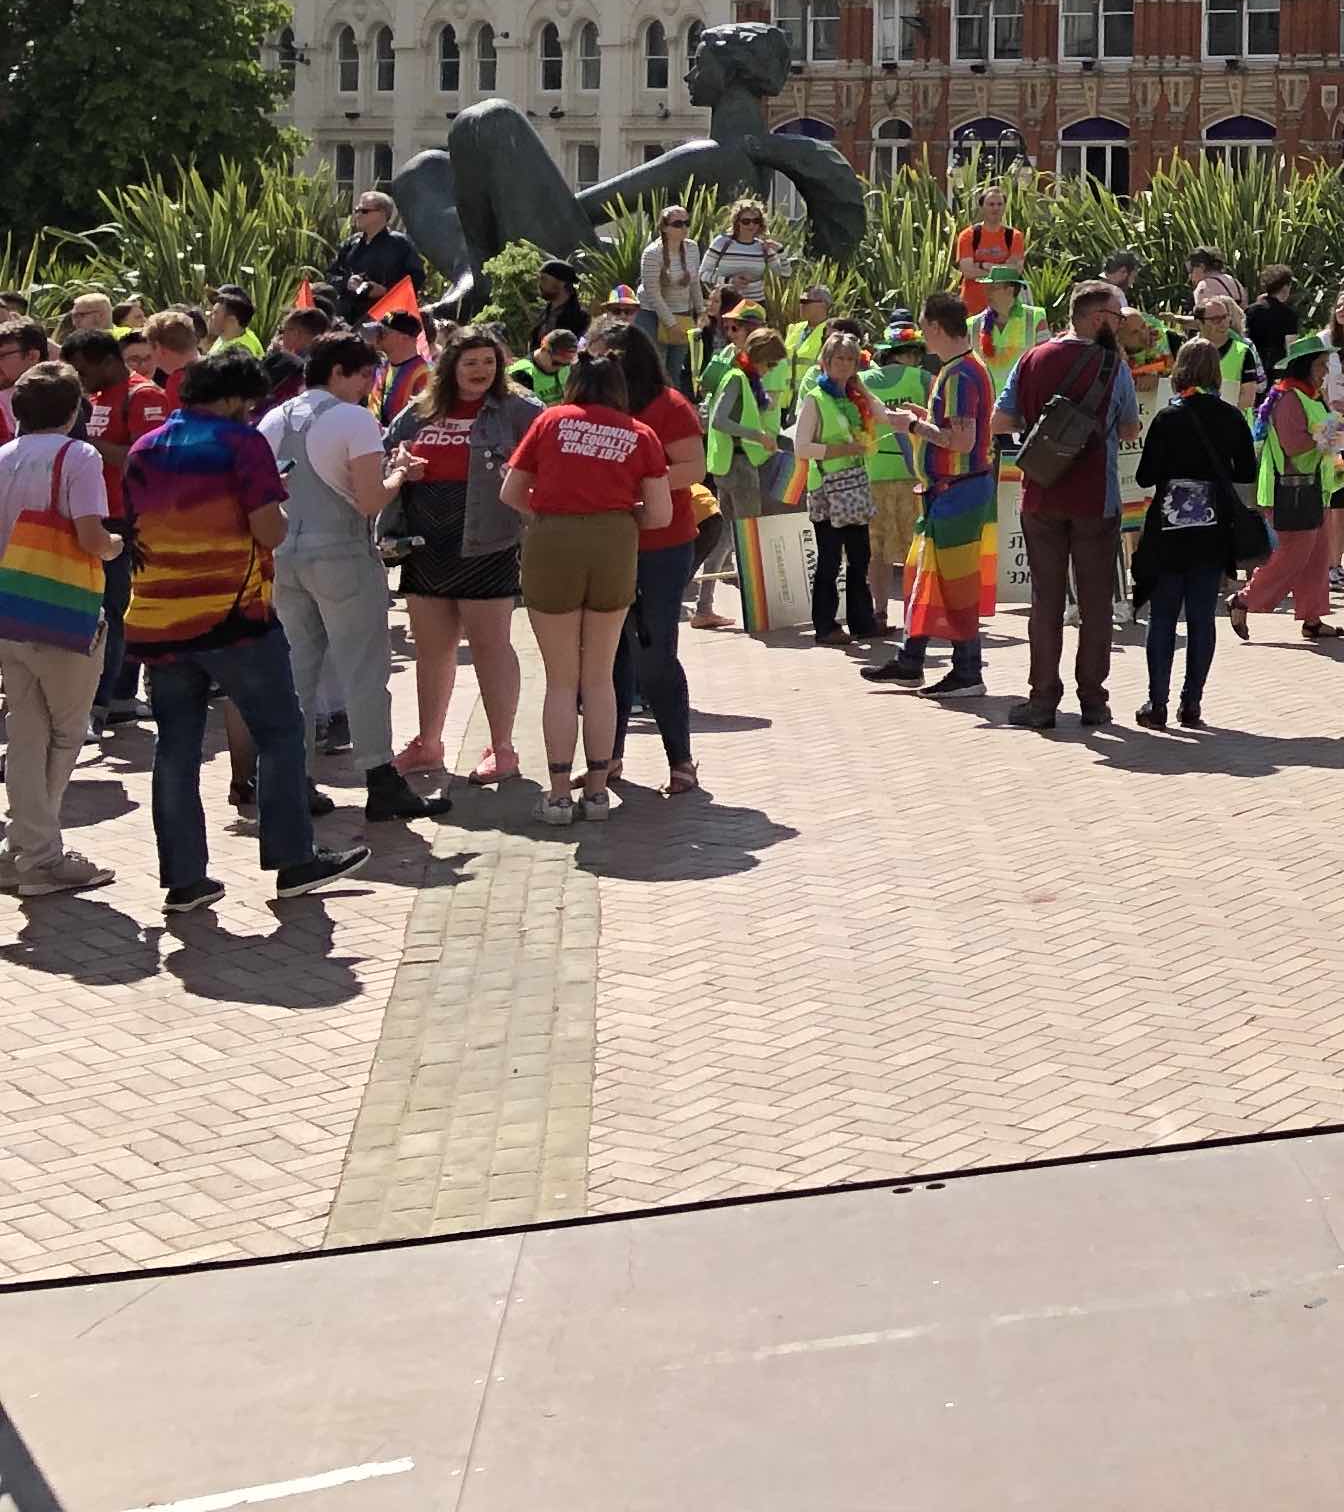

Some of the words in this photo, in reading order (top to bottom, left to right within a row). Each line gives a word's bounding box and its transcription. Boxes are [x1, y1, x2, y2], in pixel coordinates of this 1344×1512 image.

[558, 430, 581, 441] FOR
[582, 433, 637, 454] EQUALITY
[559, 418, 639, 443] CAMPAIGNING
[561, 442, 598, 456] SINCE
